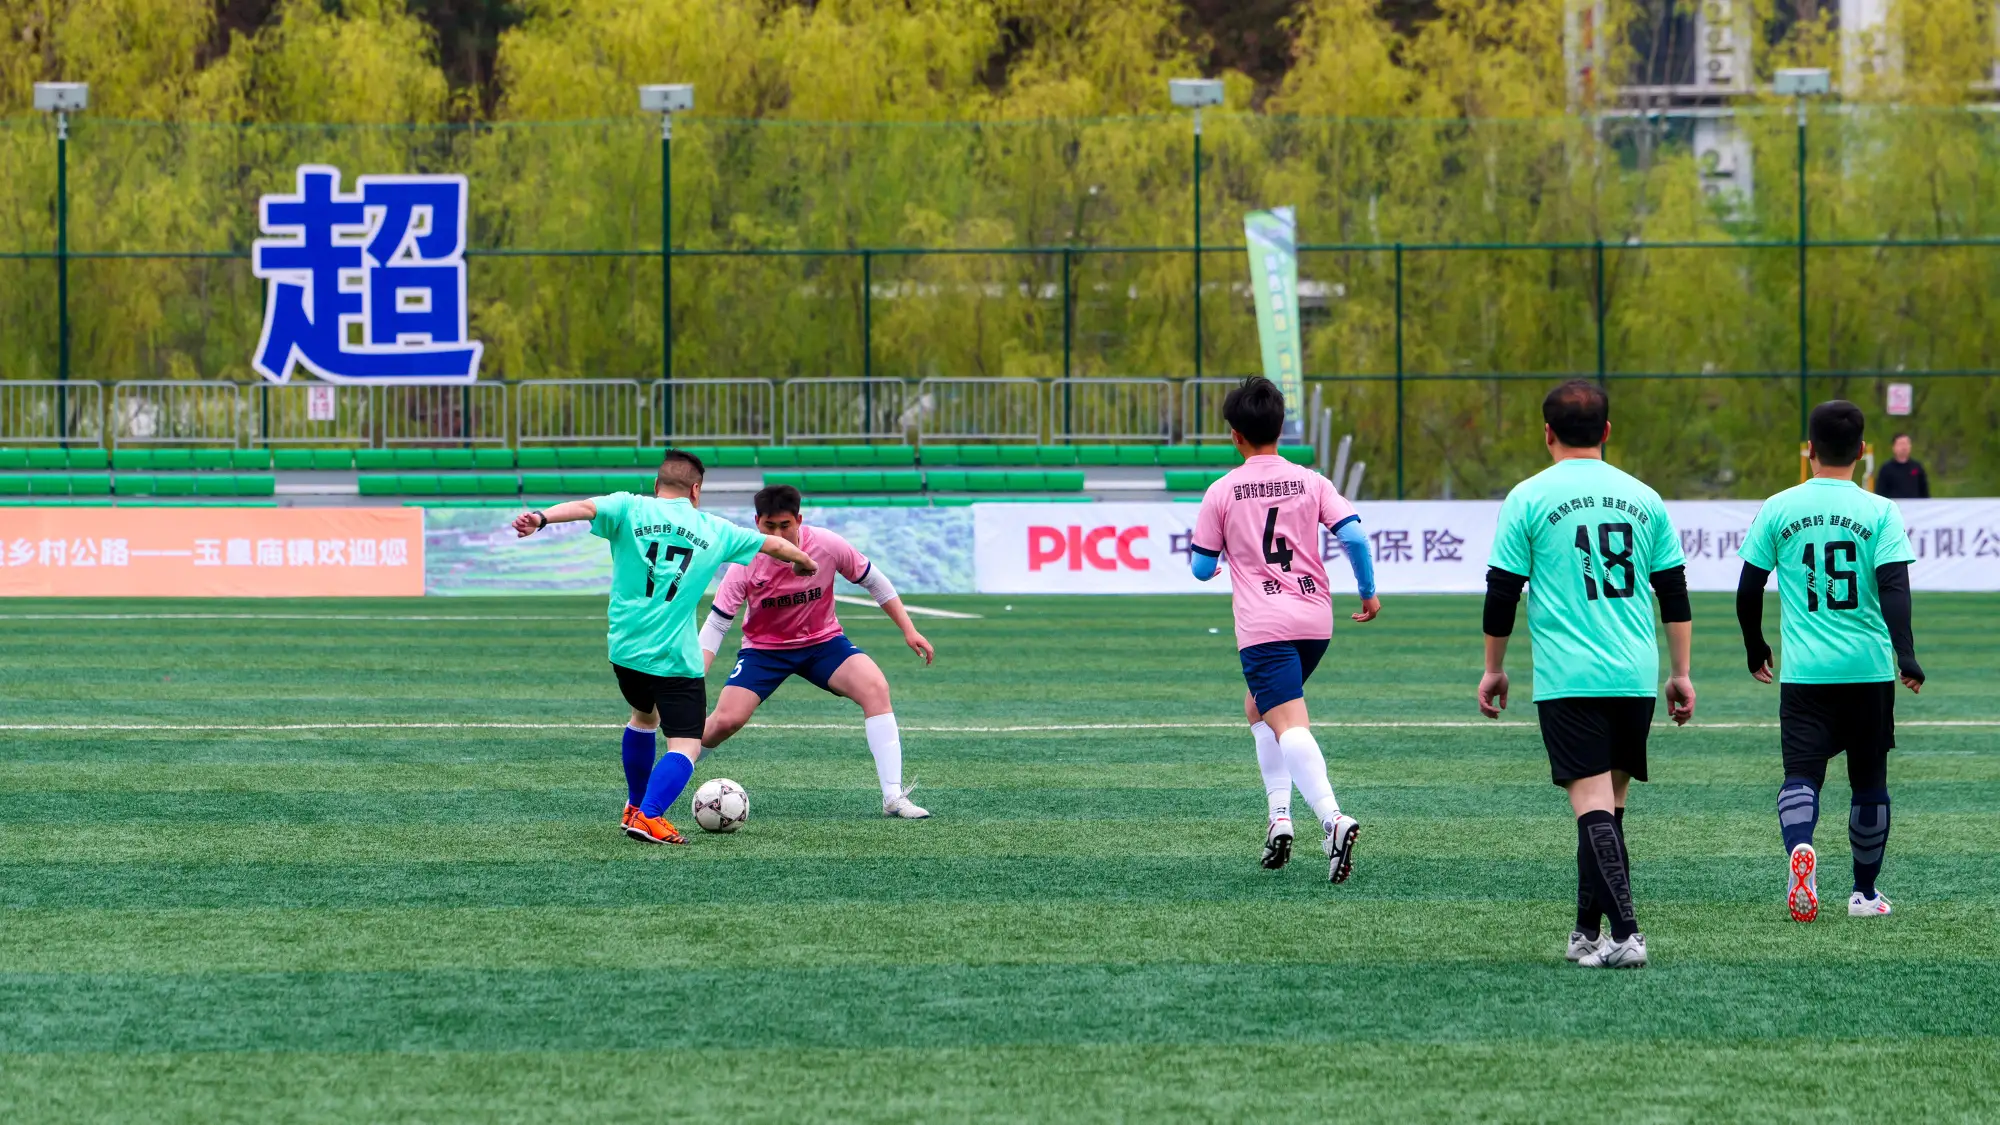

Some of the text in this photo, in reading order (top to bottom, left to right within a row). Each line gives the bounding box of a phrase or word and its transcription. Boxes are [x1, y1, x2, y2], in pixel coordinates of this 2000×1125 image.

[254, 165, 483, 383] 超
[1547, 496, 1649, 526] 商聚秦岭 超越巅峰
[1781, 515, 1873, 541] 商聚秦岭 超越巅峰
[0, 537, 408, 567] 乡村公路——玉皇庙镇欢迎您
[1027, 525, 1150, 571] PICC
[1262, 507, 1293, 572] 4
[1574, 523, 1635, 601] 18
[645, 541, 694, 603] 17
[1802, 541, 1858, 612] 16
[761, 587, 822, 609] 陕西商超
[729, 658, 745, 679] 5
